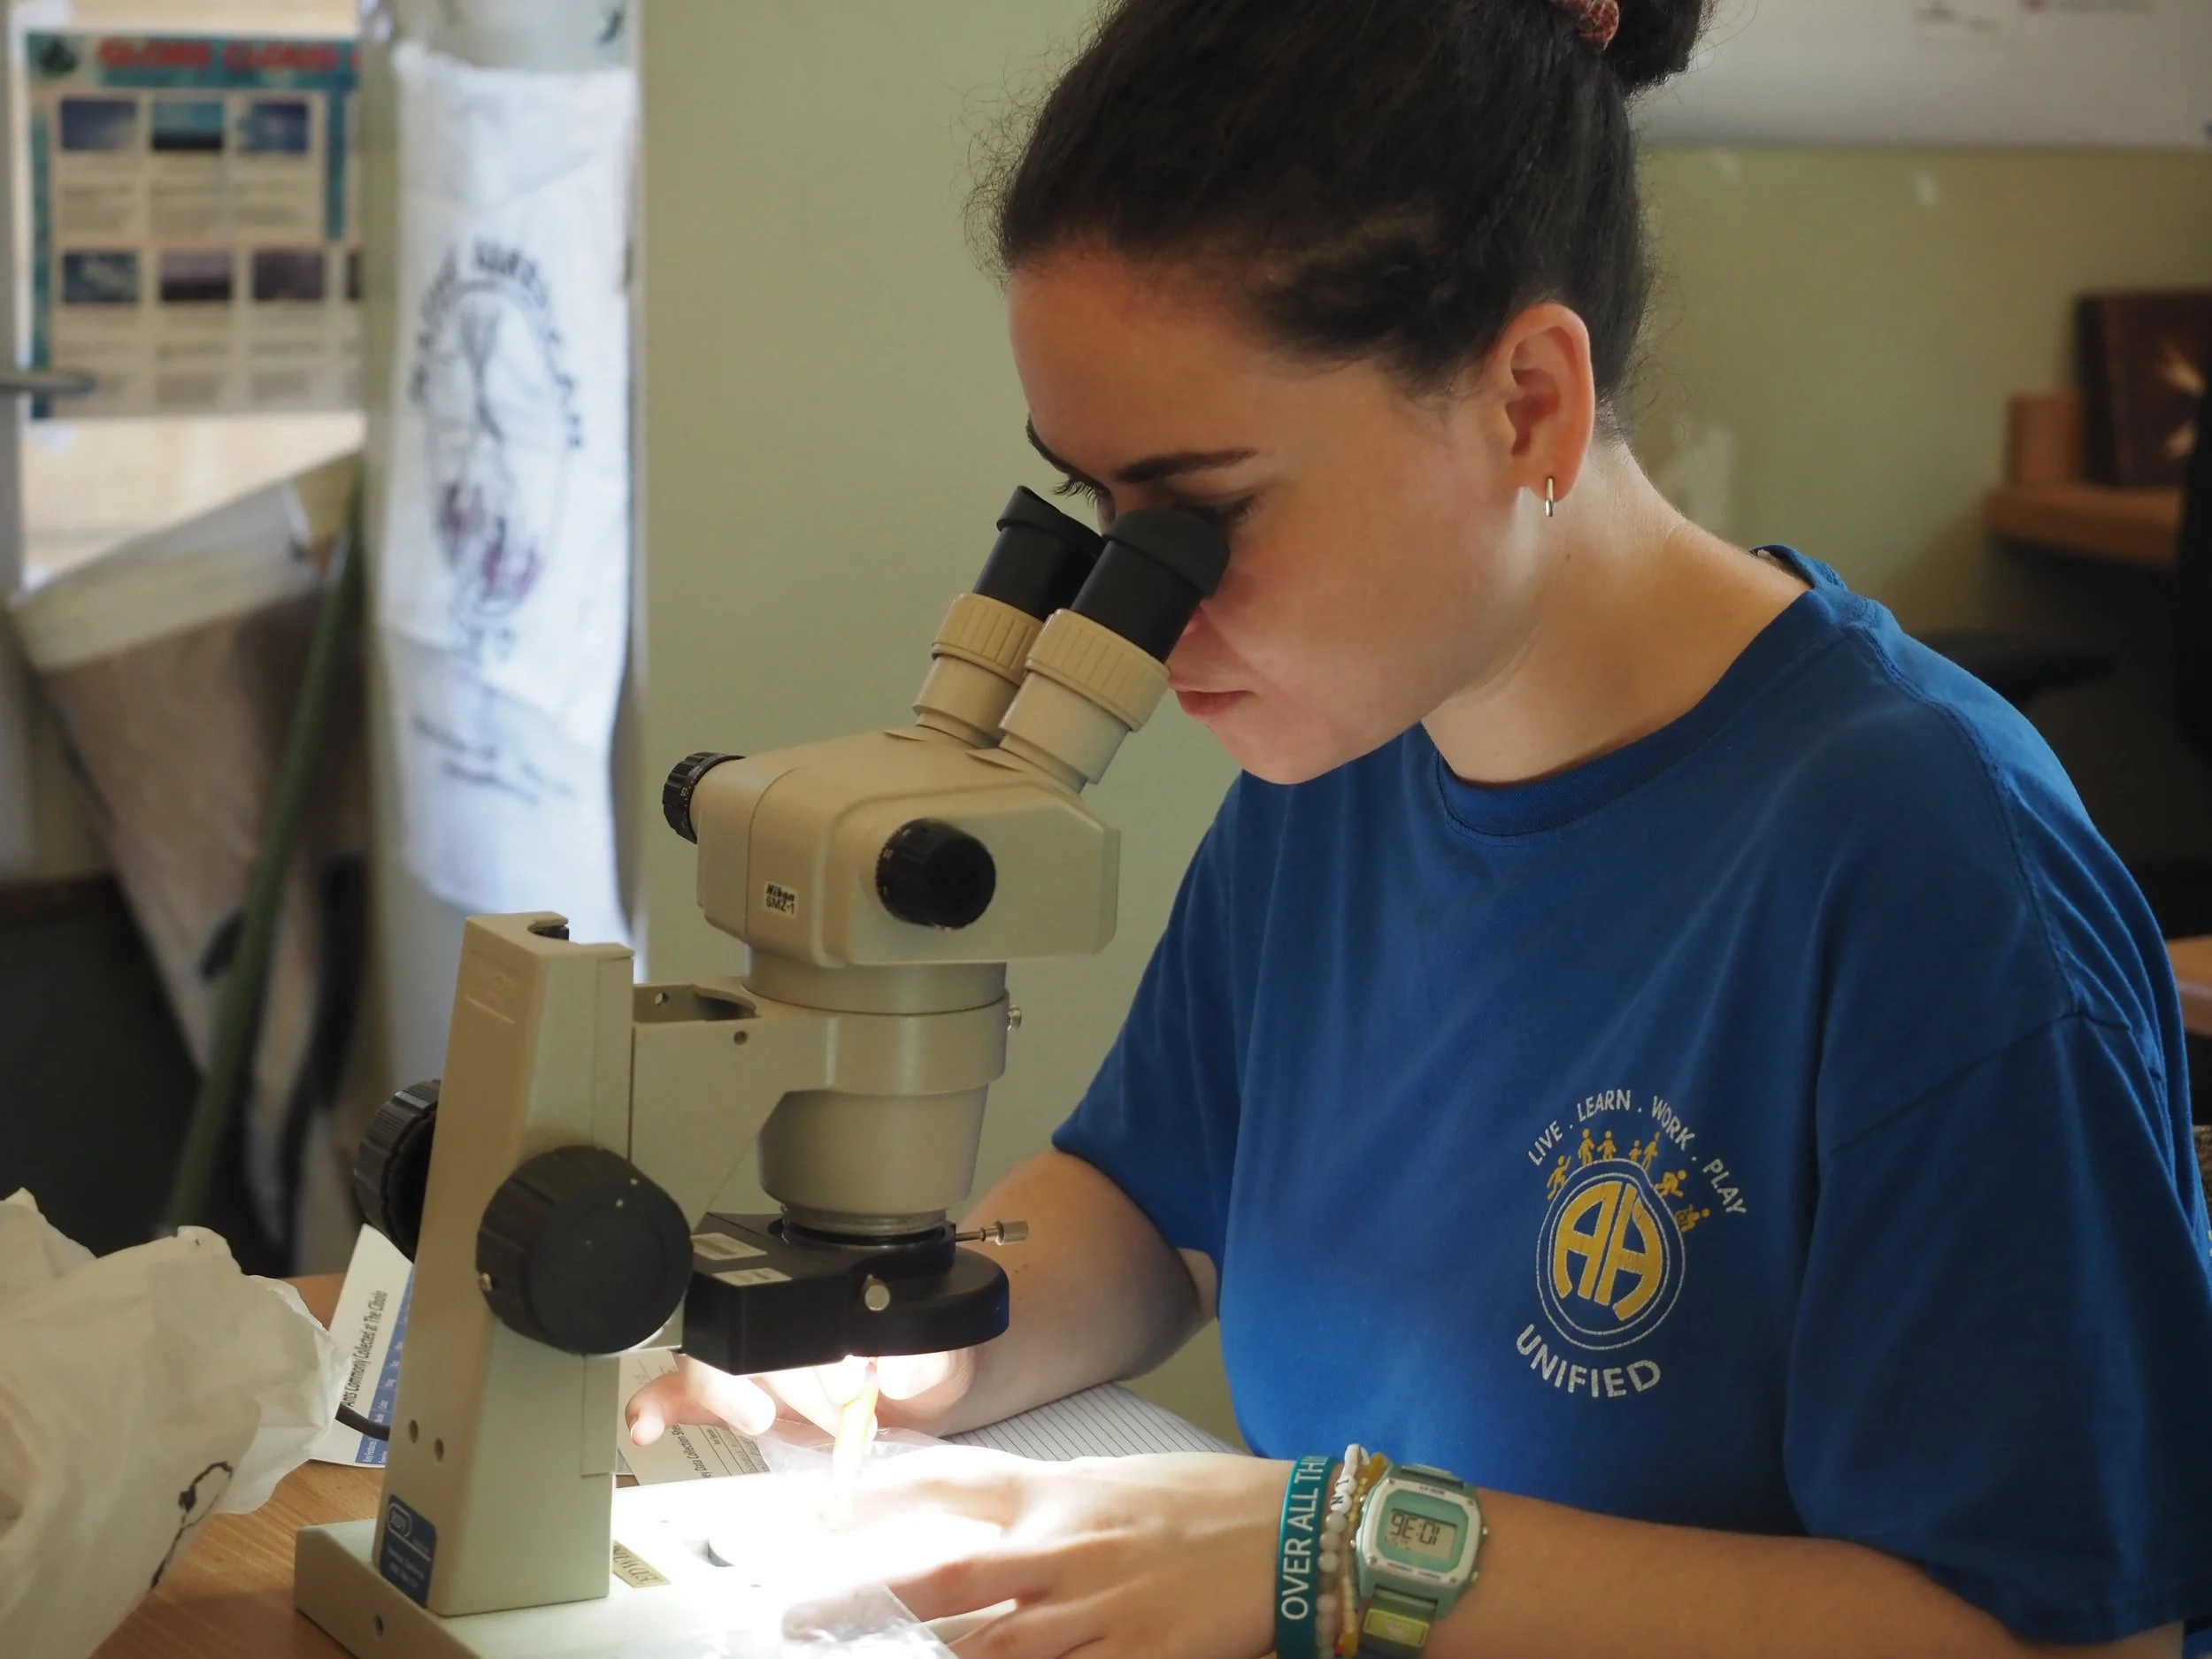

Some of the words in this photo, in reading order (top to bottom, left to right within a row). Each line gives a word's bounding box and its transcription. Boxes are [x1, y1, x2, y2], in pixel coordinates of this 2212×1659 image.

[765, 883, 795, 902] Nikon
[1528, 1120, 1563, 1166] LIVE
[1577, 1089, 1632, 1122] LEARN
[1651, 1095, 1696, 1151] WORK
[1702, 1158, 1747, 1215] PLAY
[363, 1310, 382, 1325] The
[364, 1322, 378, 1333] at
[352, 1329, 376, 1359] Collected
[344, 1357, 372, 1393] Commonly
[1516, 1324, 1662, 1398] UNIFIED
[342, 1391, 358, 1408] Ants
[677, 1434, 699, 1460] Collection
[692, 1458, 707, 1472] Data
[1286, 1487, 1318, 1532] ALL
[1389, 1511, 1441, 1547] 10:36
[1281, 1538, 1311, 1620] OVER
